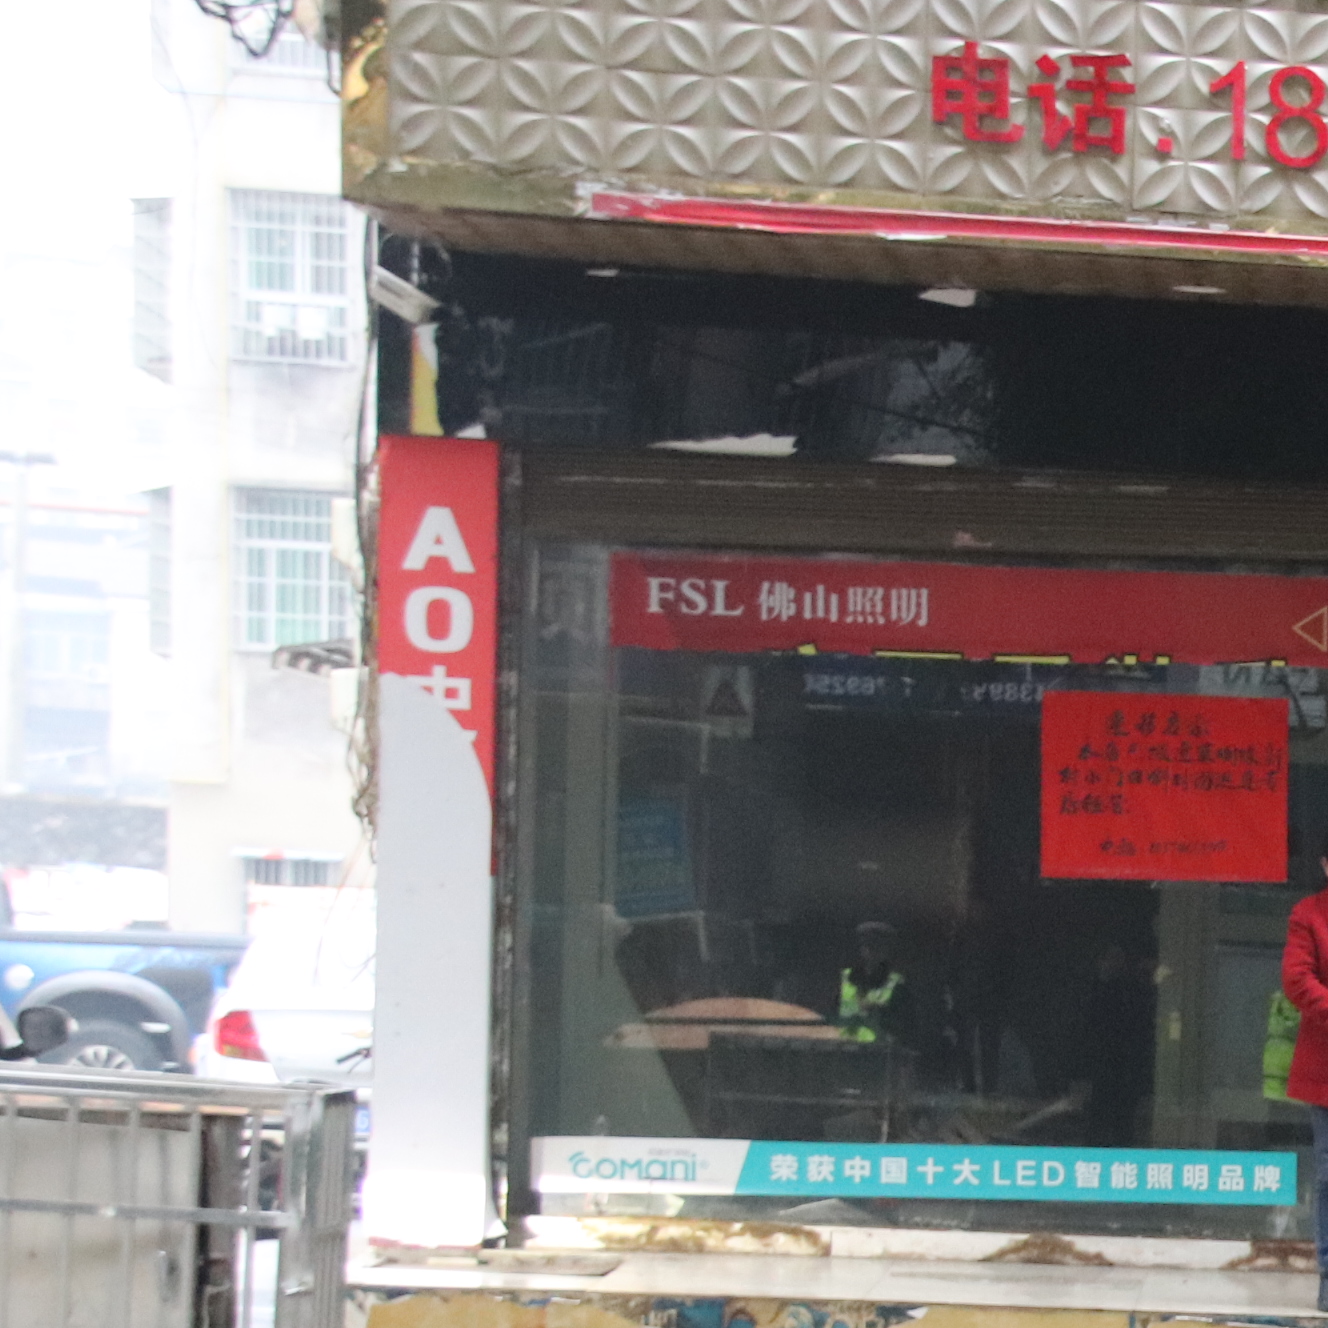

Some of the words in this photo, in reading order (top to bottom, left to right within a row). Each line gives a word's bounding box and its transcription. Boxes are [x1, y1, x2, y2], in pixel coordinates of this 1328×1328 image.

[647, 577, 745, 616] FSL
[757, 580, 929, 627] 佛山照明
[769, 1153, 1282, 1193] 荣获中国十大LED智能照明品牌
